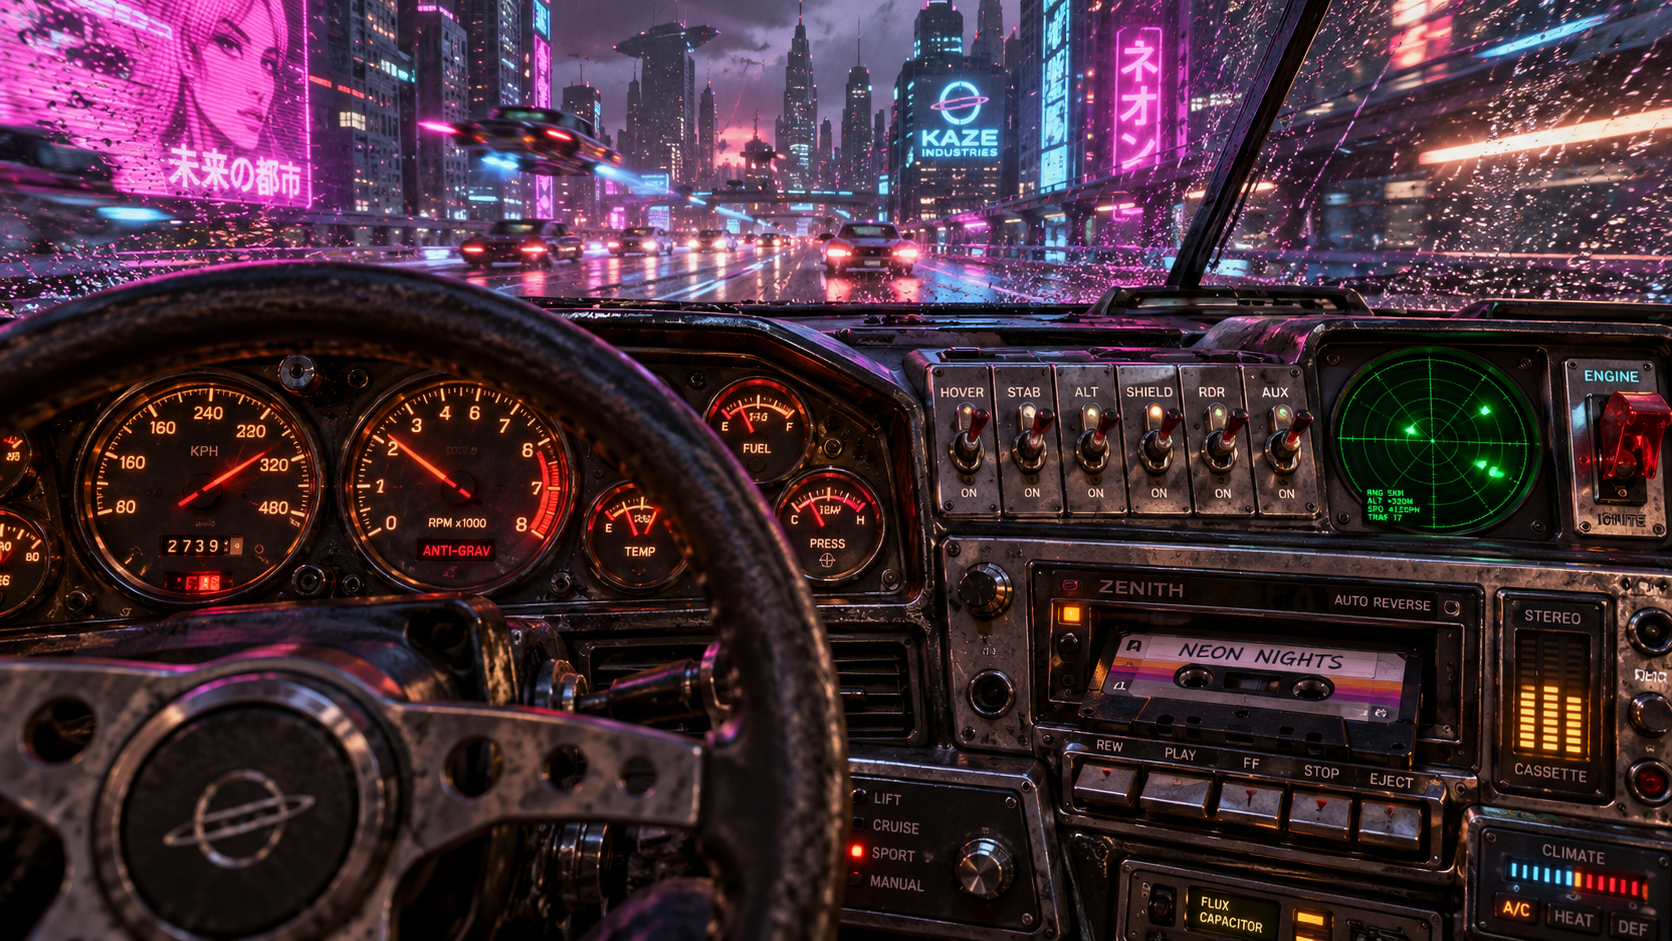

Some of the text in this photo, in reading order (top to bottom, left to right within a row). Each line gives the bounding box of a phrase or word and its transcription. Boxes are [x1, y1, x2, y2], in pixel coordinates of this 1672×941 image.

[1120, 40, 1158, 170] ネオン
[921, 129, 998, 147] KAZE
[921, 148, 998, 157] INDUSTRIES
[168, 143, 300, 195] 未来の都市
[1584, 370, 1640, 383] ENGINE
[940, 387, 984, 398] HOVER
[1007, 387, 1041, 398] STAB
[1075, 387, 1099, 398] ALT
[1126, 387, 1173, 398] SHIELD
[1199, 387, 1225, 398] RDR
[1261, 387, 1289, 398] AUX
[193, 406, 223, 420] 240
[439, 406, 451, 420] 4
[469, 406, 480, 420] 6
[150, 421, 176, 435] 160
[236, 425, 266, 438] 220
[411, 418, 422, 433] 3
[499, 419, 510, 433] 7
[721, 422, 729, 431] E
[786, 422, 794, 432] F
[190, 445, 219, 457] KPH
[387, 441, 399, 456] 2
[522, 443, 534, 457] 6
[743, 444, 771, 454] FUEL
[119, 456, 146, 469] 160
[259, 458, 289, 472] 320
[376, 479, 385, 494] 1
[531, 481, 542, 495] 7
[961, 488, 977, 498] ON
[1024, 488, 1040, 498] ON
[1088, 488, 1104, 498] ON
[1151, 488, 1167, 498] ON
[1215, 488, 1231, 498] ON
[1278, 488, 1295, 498] ON
[115, 500, 136, 514] 80
[258, 501, 289, 515] 480
[386, 515, 397, 530] 0
[428, 518, 487, 528] RPM x1000
[515, 517, 528, 532] 8
[791, 514, 799, 525] C
[856, 515, 865, 525] H
[605, 523, 612, 533] E
[810, 538, 846, 549] PRESS
[422, 545, 491, 557] ANTI-GRAV
[624, 546, 656, 557] TEMP
[1099, 579, 1184, 598] ZENITH
[1334, 594, 1431, 611] AUTO REVERSE
[1524, 609, 1582, 625] STEREO
[1178, 643, 1344, 670] NEON NIGHTS
[1096, 740, 1124, 753] REW
[1164, 748, 1197, 762] PLAY
[1243, 757, 1260, 769] FF
[1304, 765, 1340, 779] STOP
[1514, 762, 1588, 783] CASSETTE
[1369, 773, 1414, 789] EJECT
[873, 792, 902, 806] LIFT
[872, 818, 920, 835] CRUISE
[871, 846, 915, 863] SPORT
[1542, 843, 1606, 865] CLIMATE
[869, 874, 924, 892] MANUAL
[1201, 896, 1230, 911] FLUX
[1502, 901, 1530, 917] A/C
[1199, 911, 1264, 934] CAPACITOR
[1554, 909, 1595, 928] HEAT
[1618, 919, 1649, 937] DEF
